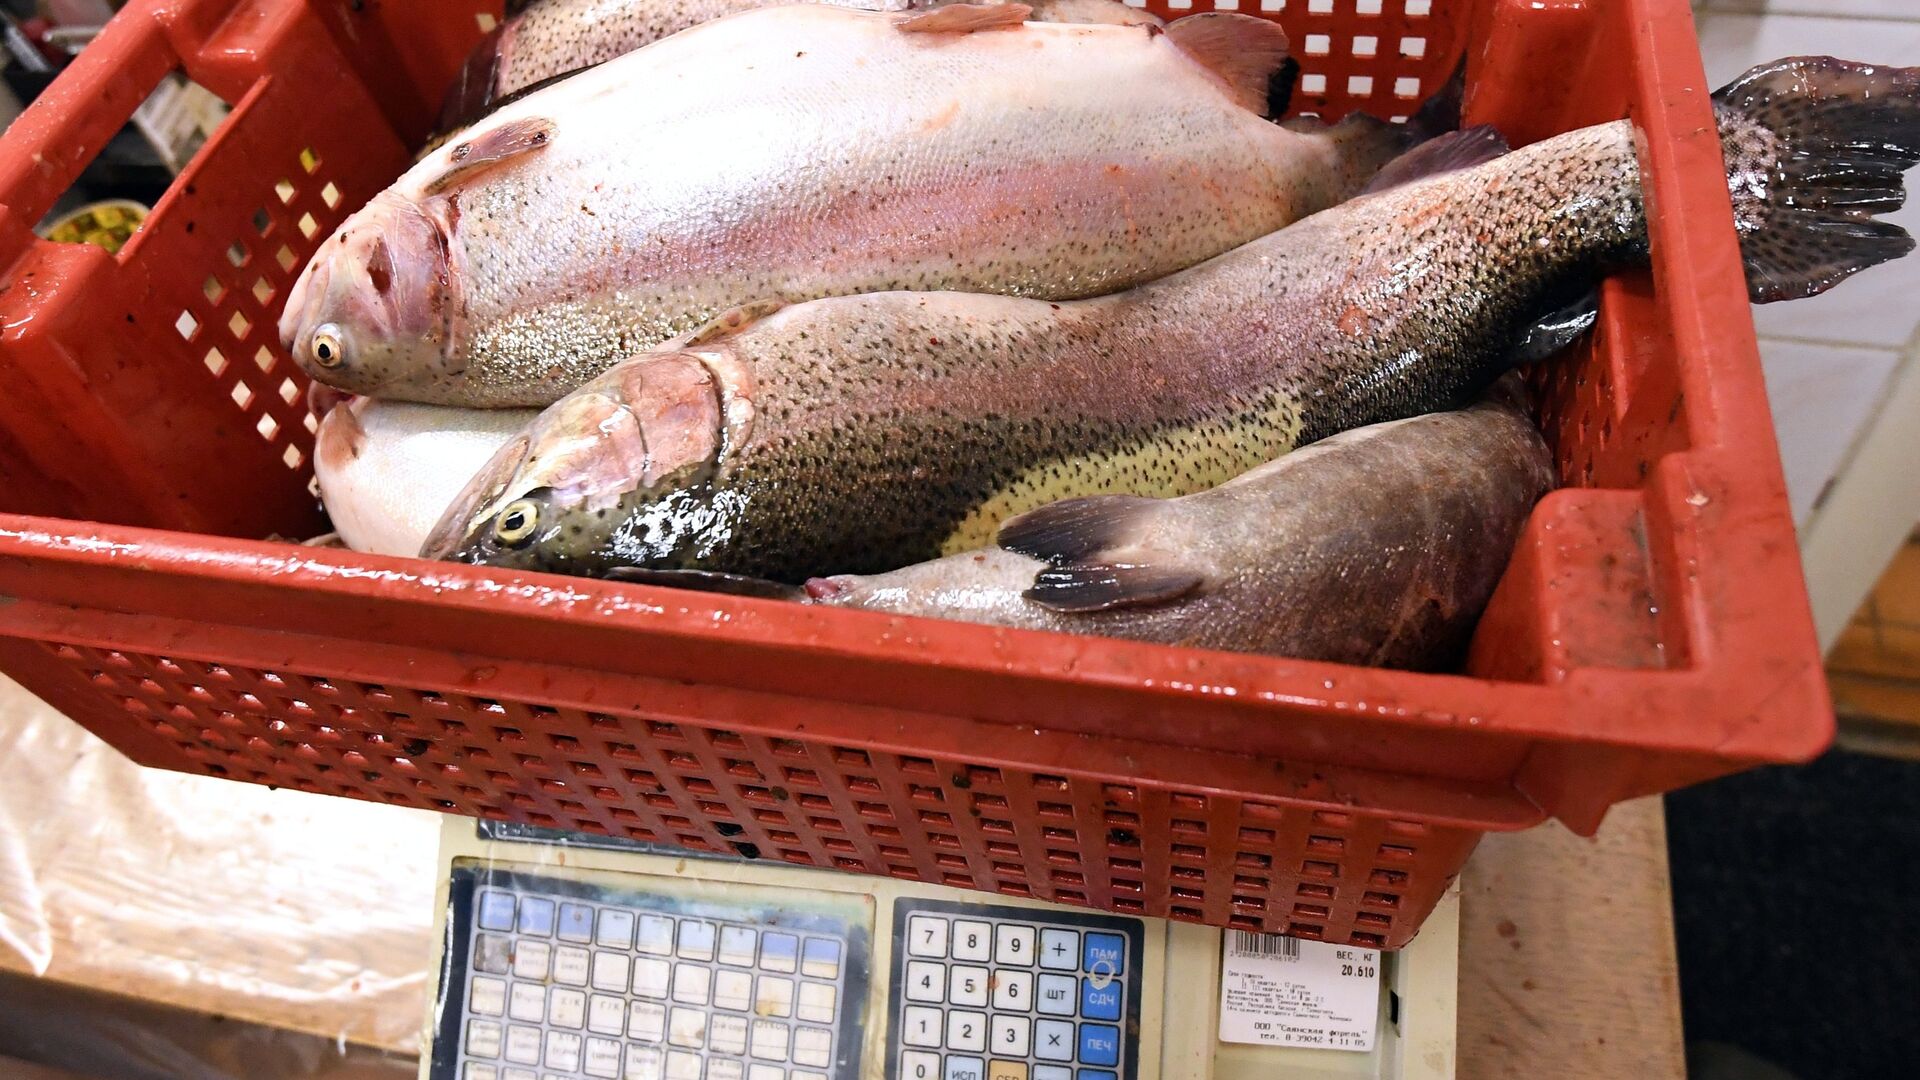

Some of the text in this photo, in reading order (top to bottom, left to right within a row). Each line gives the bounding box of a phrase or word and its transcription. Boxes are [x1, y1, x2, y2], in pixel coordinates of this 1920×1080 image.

[924, 929, 934, 944] 7
[967, 934, 977, 948] 8
[1011, 938, 1021, 952] 9
[1090, 947, 1117, 961] ПАМ
[1341, 964, 1375, 978] 20.610
[921, 975, 1018, 998] 4 5 6
[1088, 992, 1115, 1007] СДЧ
[919, 1020, 926, 1033] 1
[962, 1024, 972, 1038] 2
[1006, 1028, 1016, 1042] 3
[1087, 1037, 1112, 1051] ПЕЧ
[916, 1063, 925, 1079] 0
